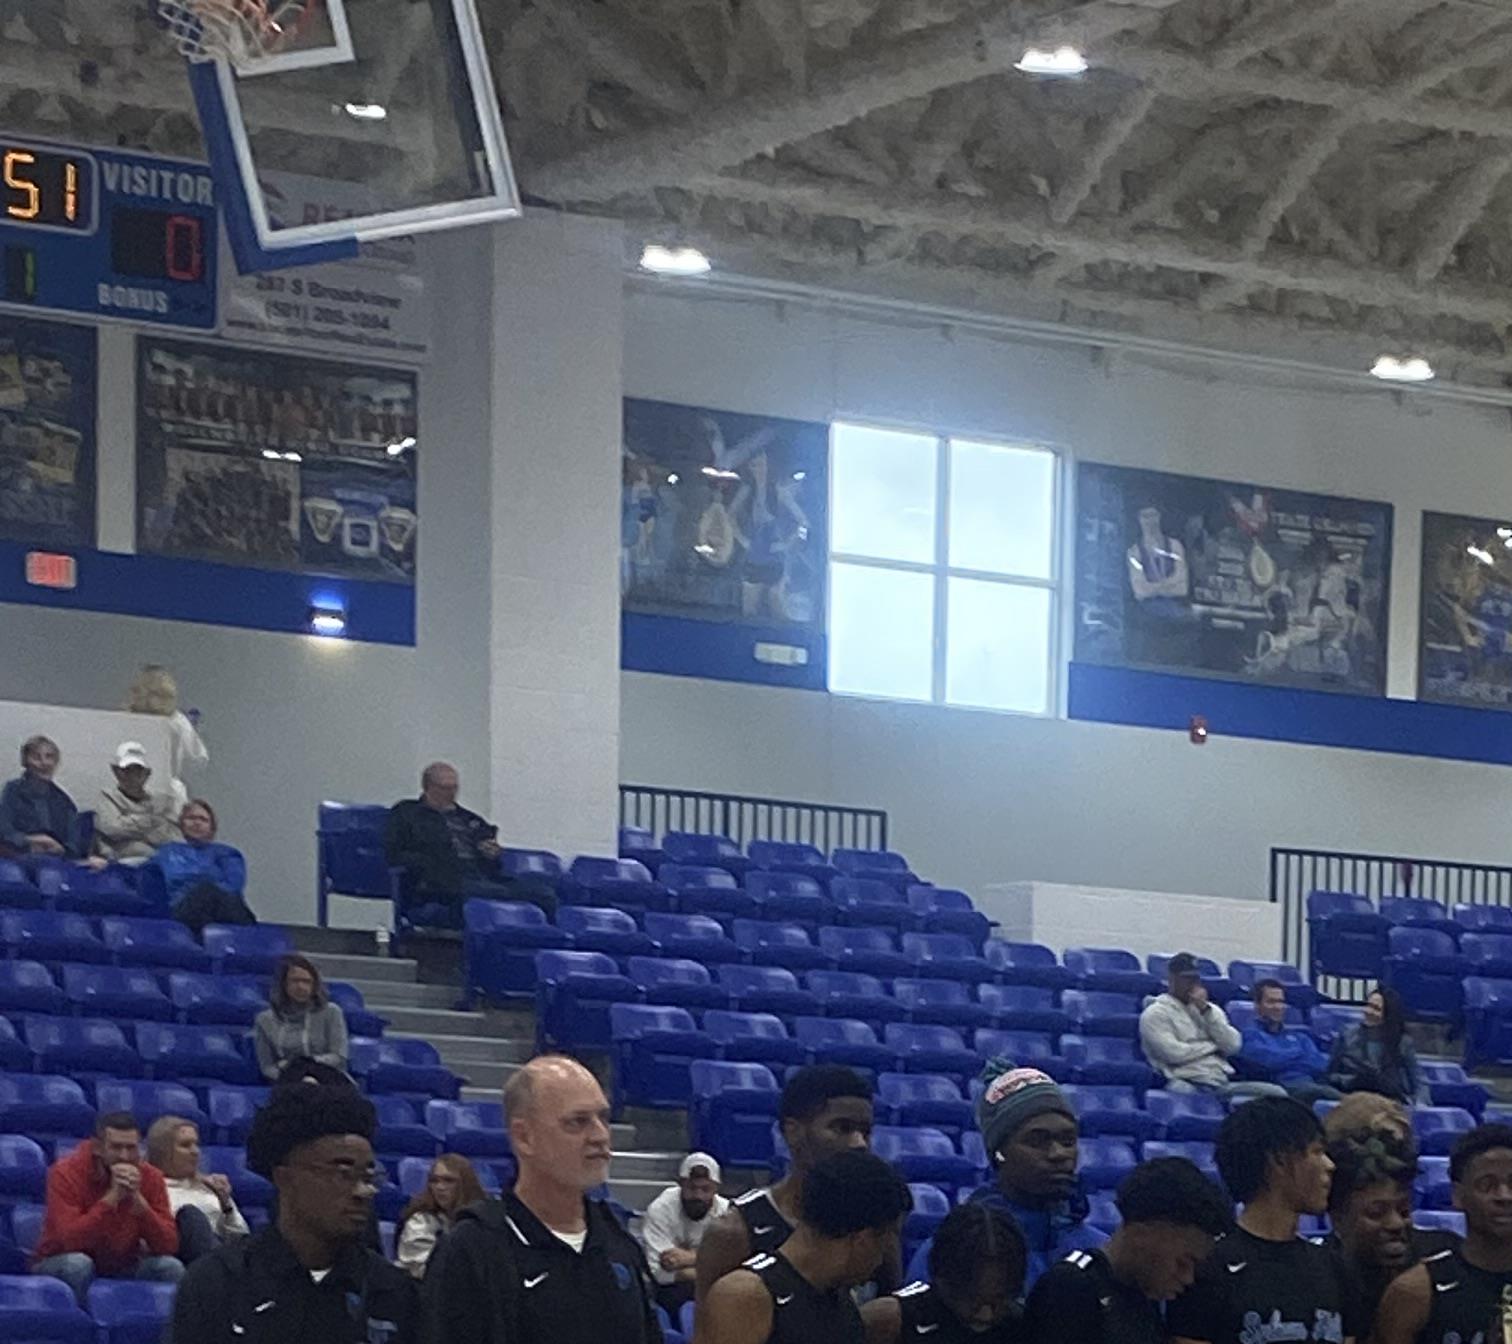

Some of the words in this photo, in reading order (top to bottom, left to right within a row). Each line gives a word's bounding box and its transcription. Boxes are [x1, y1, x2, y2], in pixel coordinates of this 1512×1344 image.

[3, 151, 79, 222] 51
[102, 159, 214, 207] VISITOR
[166, 214, 203, 281] 0
[97, 282, 169, 314] BONUS
